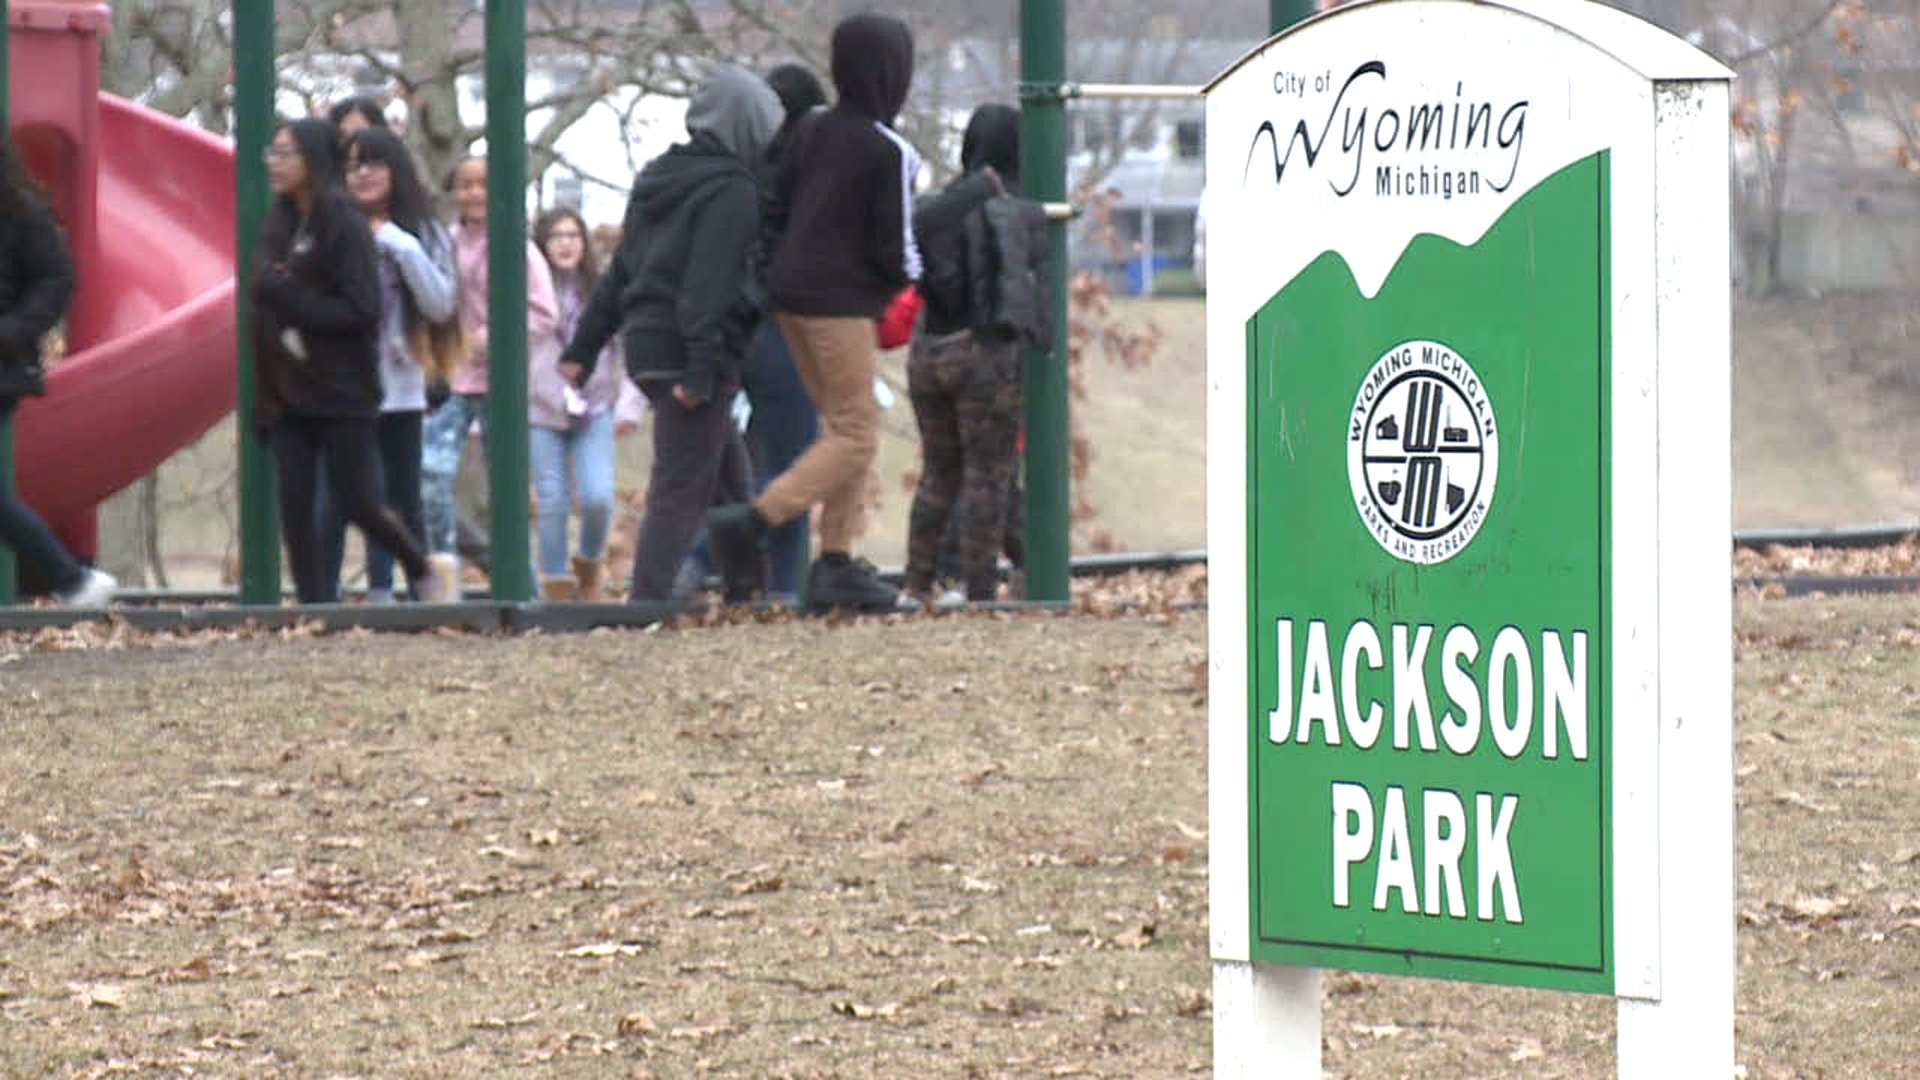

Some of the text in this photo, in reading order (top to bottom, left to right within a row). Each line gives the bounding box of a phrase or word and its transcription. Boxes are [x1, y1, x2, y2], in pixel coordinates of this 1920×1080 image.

[1243, 60, 1529, 197] Wyoming
[1273, 70, 1331, 97] City of
[1376, 166, 1480, 199] Michigan
[1350, 346, 1494, 442] WYOMING MICHIGAN
[1360, 496, 1485, 560] PARKS AND RECREATION
[1268, 617, 1588, 761] JACKSON
[1331, 780, 1524, 925] PARK
